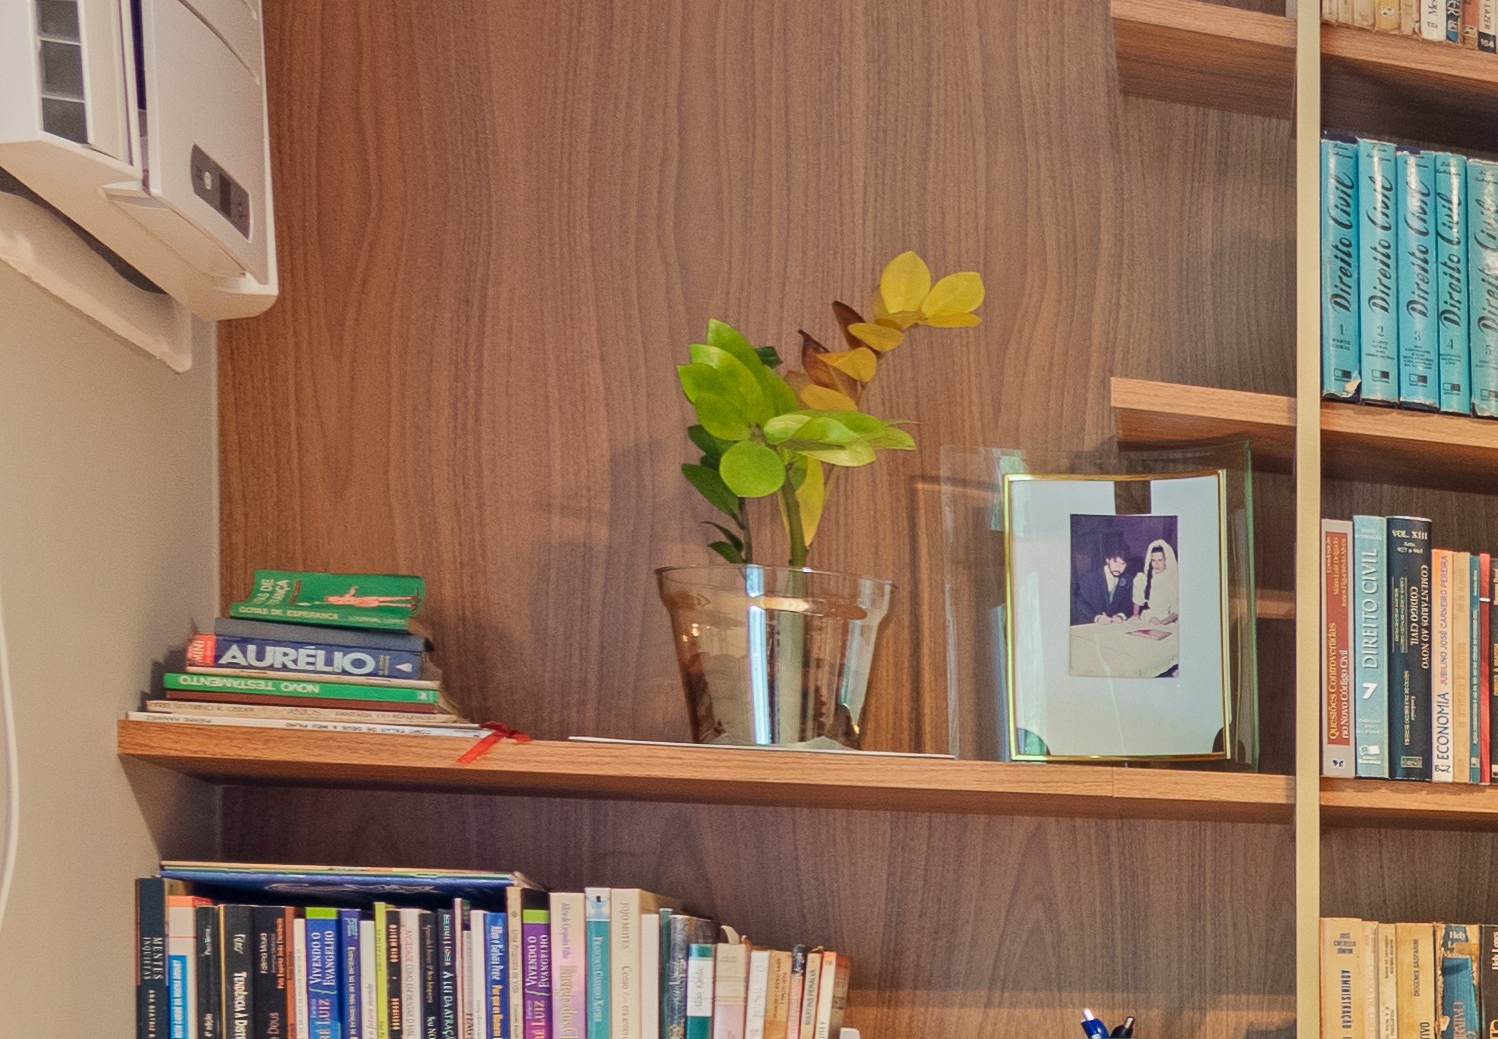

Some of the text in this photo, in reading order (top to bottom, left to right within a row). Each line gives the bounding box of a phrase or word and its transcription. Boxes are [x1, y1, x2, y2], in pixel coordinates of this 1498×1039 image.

[1327, 172, 1354, 312] Direito Civil
[1366, 175, 1393, 313] Direito Civil
[1404, 179, 1431, 318] Direito Civil
[1360, 549, 1378, 669] DIREITO CIVIL
[179, 676, 320, 694] NOVO TESTAMENTO
[217, 643, 376, 675] AURÉLIO
[1436, 692, 1449, 760] ECONOMIA
[323, 930, 336, 986] EVANGELHO
[539, 934, 550, 988] EVANGELHO
